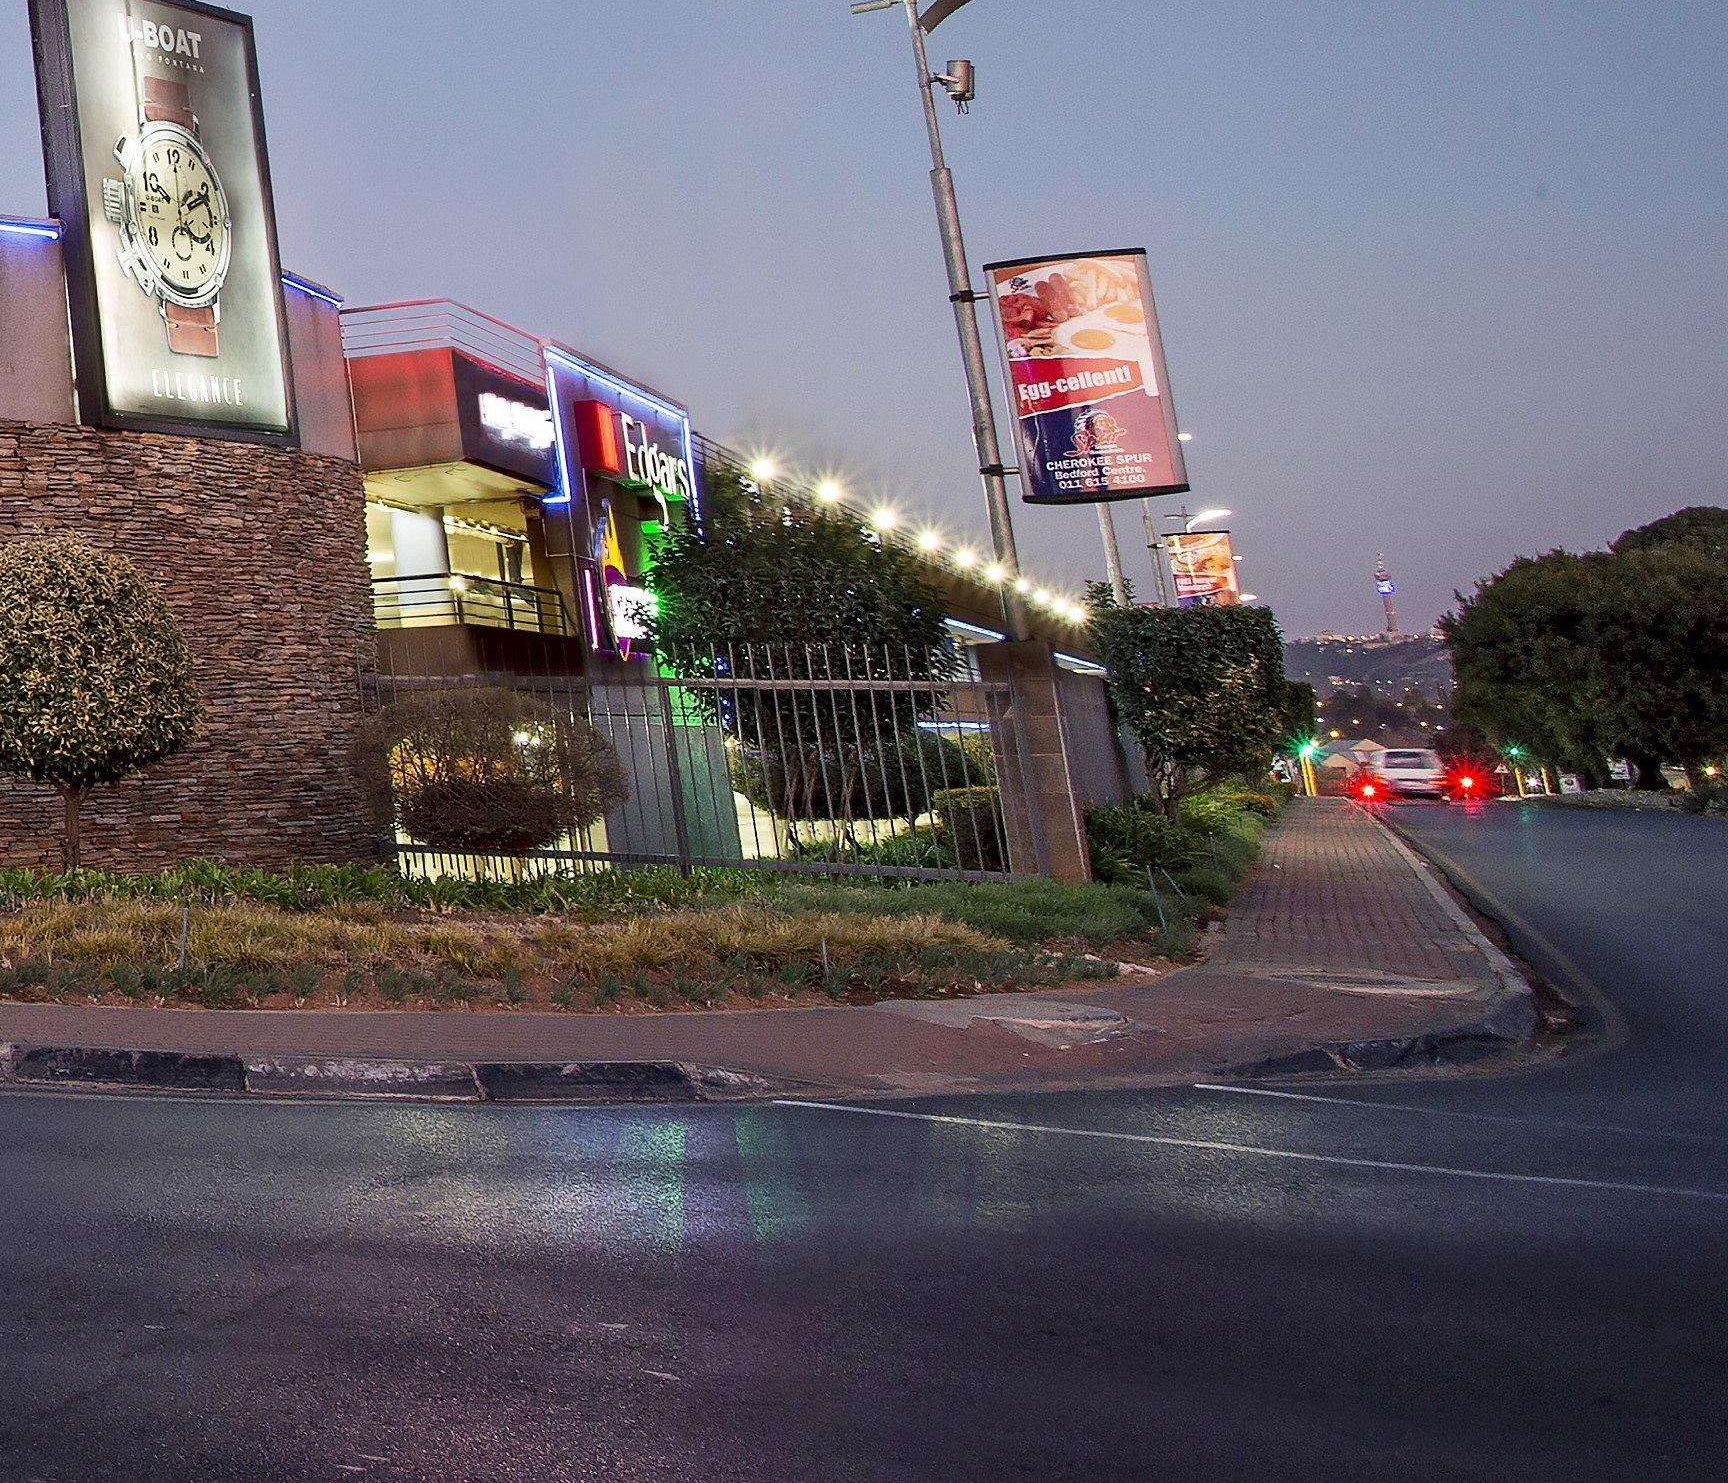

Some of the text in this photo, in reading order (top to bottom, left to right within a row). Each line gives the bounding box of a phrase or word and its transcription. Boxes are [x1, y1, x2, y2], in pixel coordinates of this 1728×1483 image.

[117, 12, 202, 59] U-BOAT
[158, 55, 205, 73] FONTANA
[166, 148, 180, 165] 12
[151, 367, 245, 407] ELEGANCE
[1017, 364, 1133, 403] Egg-cellent!
[618, 410, 691, 532] Edgars
[1046, 453, 1153, 471] CHEROKEE SPUR
[1054, 467, 1099, 480] Bedford
[1058, 474, 1145, 489] 011 615 4100
